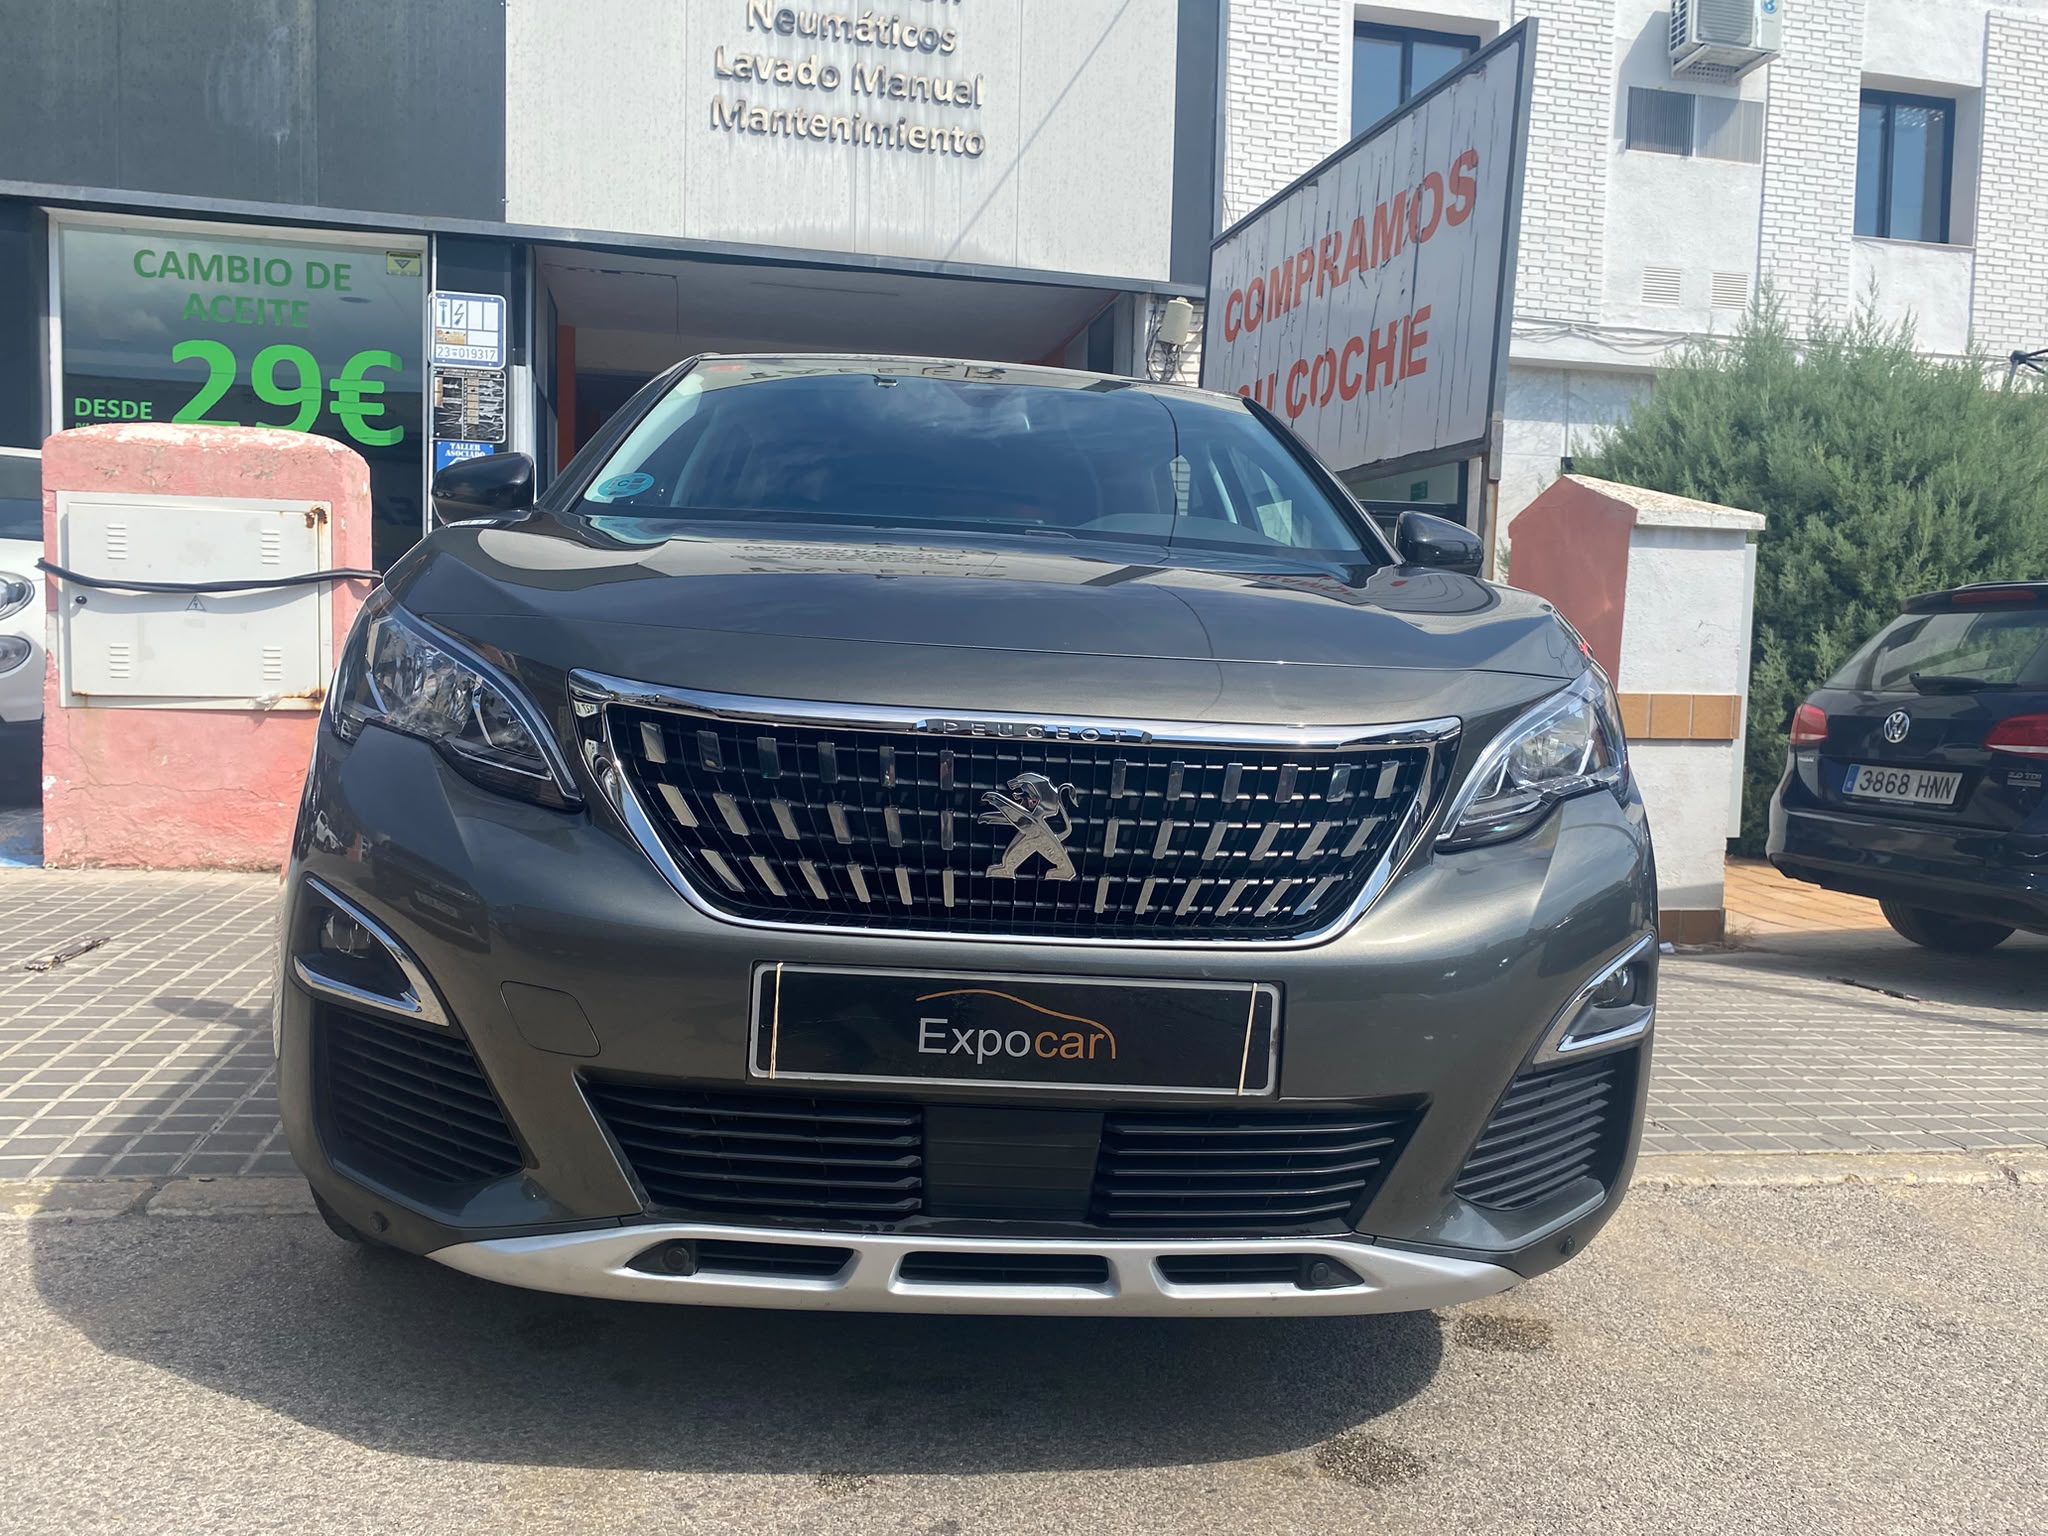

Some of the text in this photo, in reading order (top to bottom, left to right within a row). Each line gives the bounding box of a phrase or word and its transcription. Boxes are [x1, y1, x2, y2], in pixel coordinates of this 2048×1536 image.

[746, 0, 958, 55] Neumáticos
[714, 45, 985, 108] Lavado Manual
[710, 95, 986, 157] Mantenimiento
[1224, 147, 1480, 344] COMPRAMOS
[133, 248, 353, 292] CAMBIO DE
[181, 292, 311, 330] ACEITE
[1284, 303, 1433, 420] COCHE
[74, 397, 153, 420] DESDE
[171, 339, 405, 447] 29€
[445, 450, 486, 459] ASOCIADO
[449, 443, 481, 451] TALLER
[943, 721, 1128, 743] PEUGEOT
[1858, 770, 1957, 800] 3868 HNN
[917, 1017, 1117, 1064] Expocar
